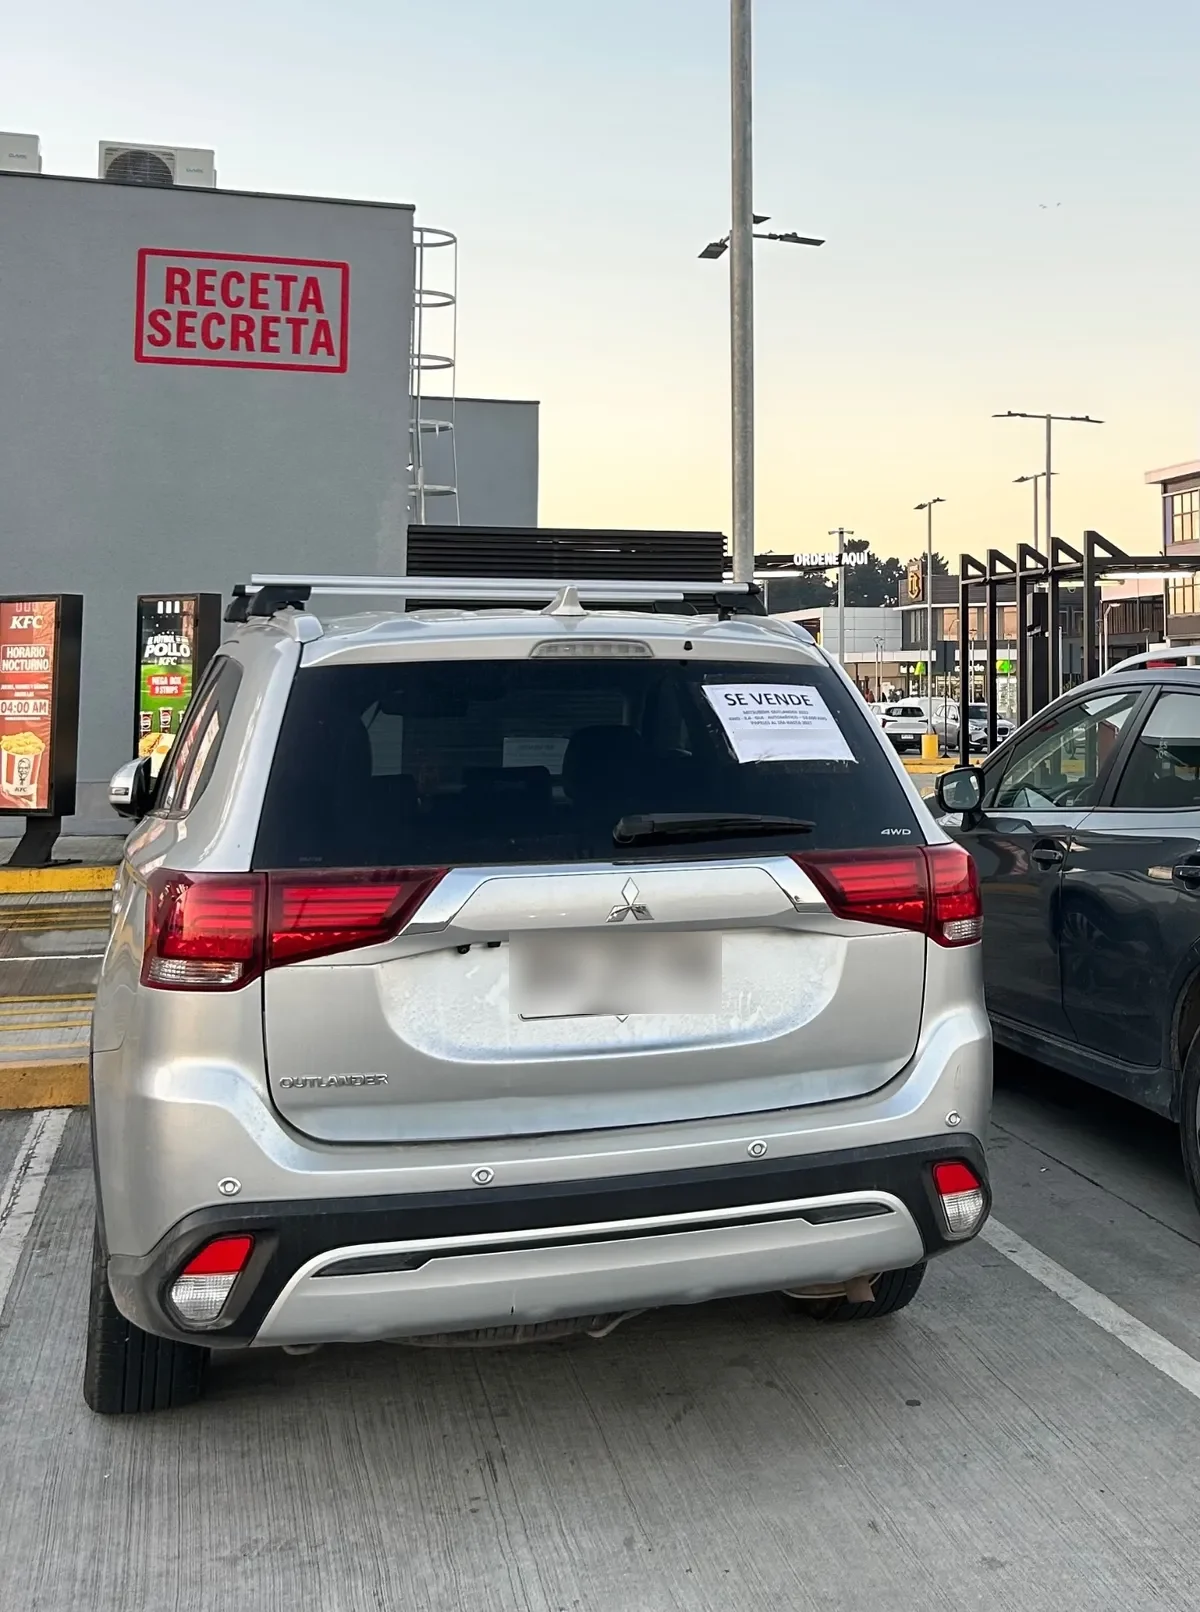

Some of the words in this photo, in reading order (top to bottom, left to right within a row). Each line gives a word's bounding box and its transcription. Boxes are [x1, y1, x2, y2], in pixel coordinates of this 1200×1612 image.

[165, 267, 325, 314] RECETA
[147, 308, 336, 356] SECRETA
[794, 552, 840, 566] ORDENE
[841, 550, 868, 566] AQUÍ
[10, 615, 44, 629] KFC
[6, 646, 46, 659] HORARIO
[144, 643, 191, 658] POLLO
[2, 659, 49, 671] NOCTURNO
[724, 693, 749, 706] SE
[749, 693, 814, 707] VENDE
[1, 701, 30, 714] 04:00
[33, 701, 47, 714] AM
[881, 828, 912, 836] 4WD
[279, 1073, 389, 1089] OUTLANDER
